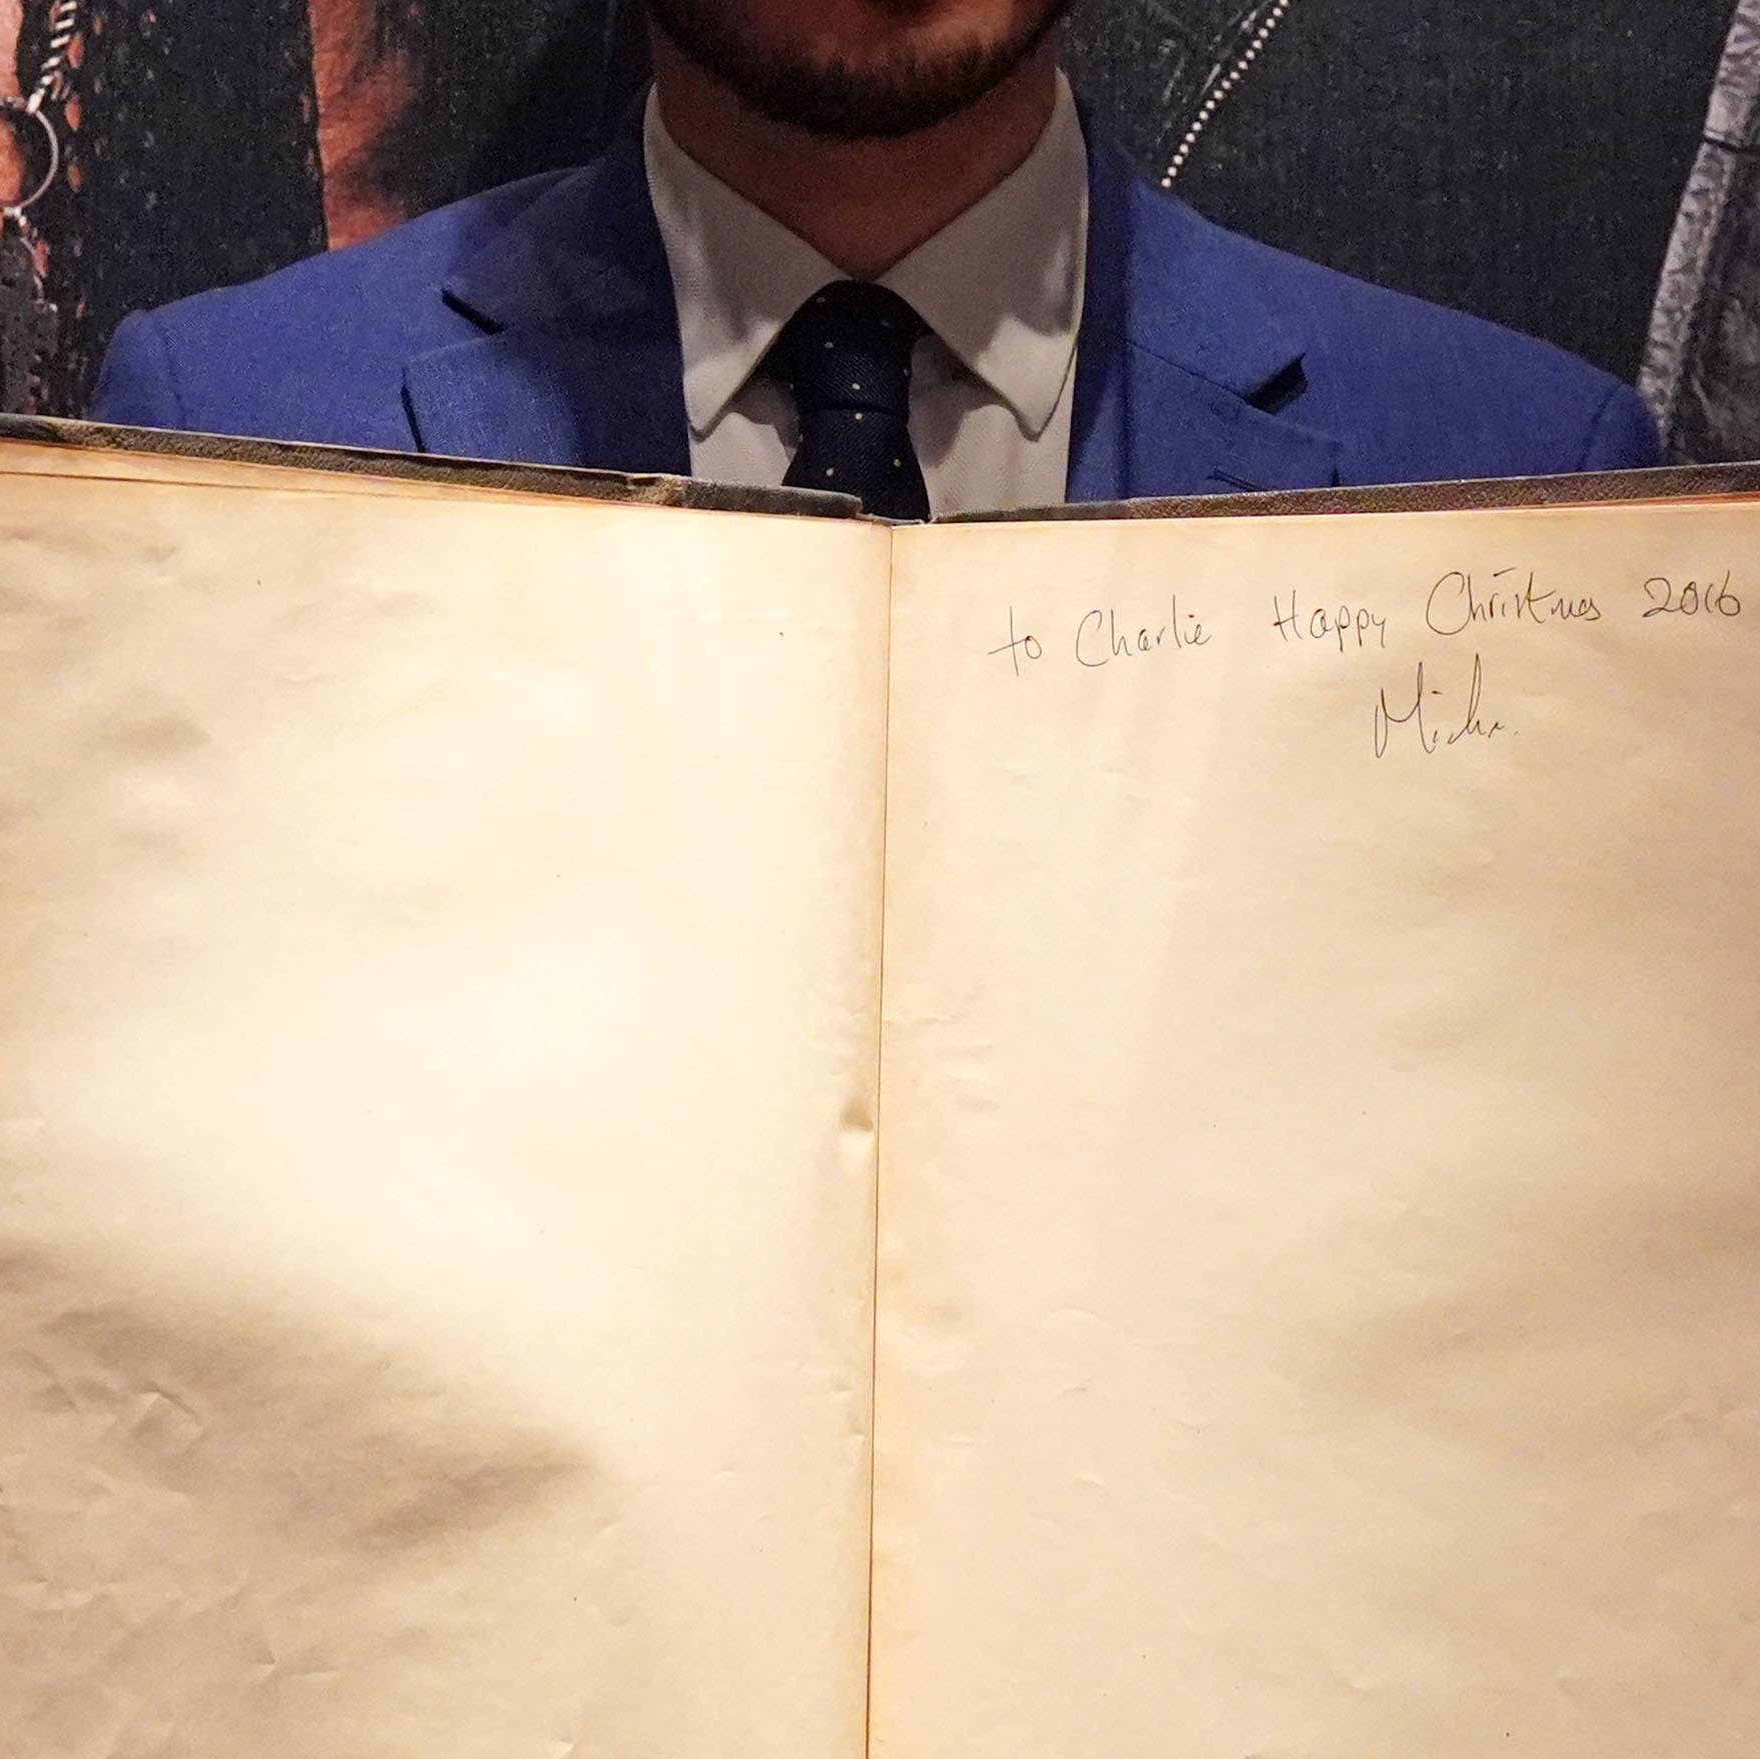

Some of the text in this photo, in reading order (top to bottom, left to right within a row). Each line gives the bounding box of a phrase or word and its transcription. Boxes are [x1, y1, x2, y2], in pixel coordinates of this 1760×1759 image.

[987, 605, 1043, 677] to
[1075, 594, 1212, 667] Charlie
[1272, 589, 1387, 652] Happy
[1642, 570, 1742, 618] 2016
